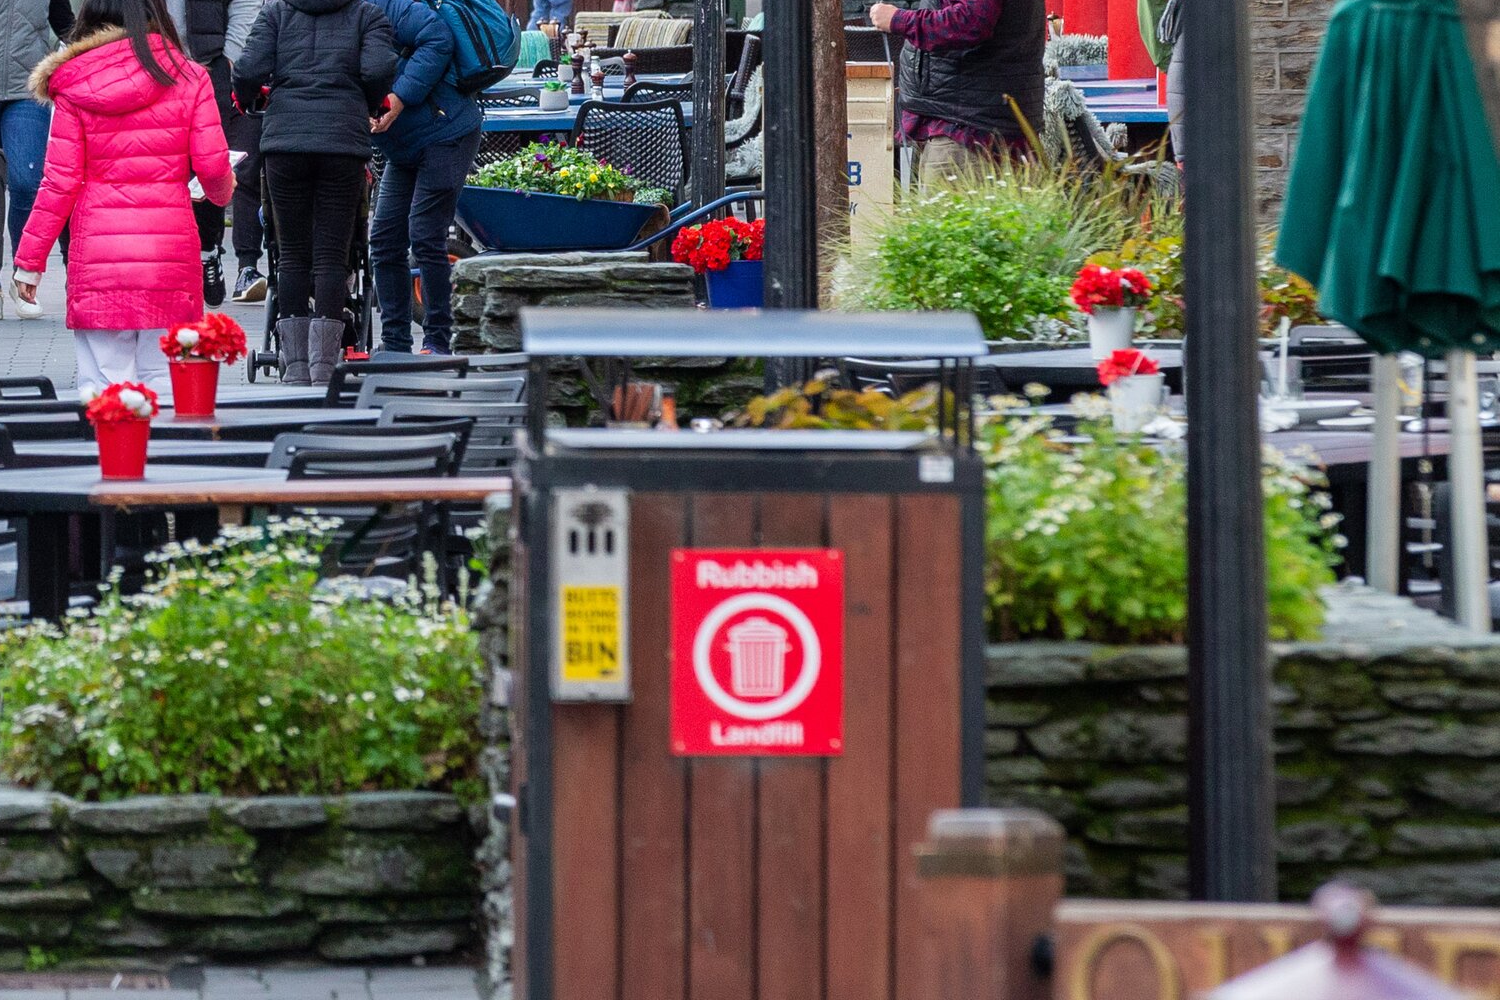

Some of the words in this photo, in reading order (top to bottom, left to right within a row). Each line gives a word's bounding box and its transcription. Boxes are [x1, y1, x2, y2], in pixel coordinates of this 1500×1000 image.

[696, 560, 819, 589] Rubbish
[566, 640, 618, 665] BIN
[710, 720, 805, 746] Landfill
